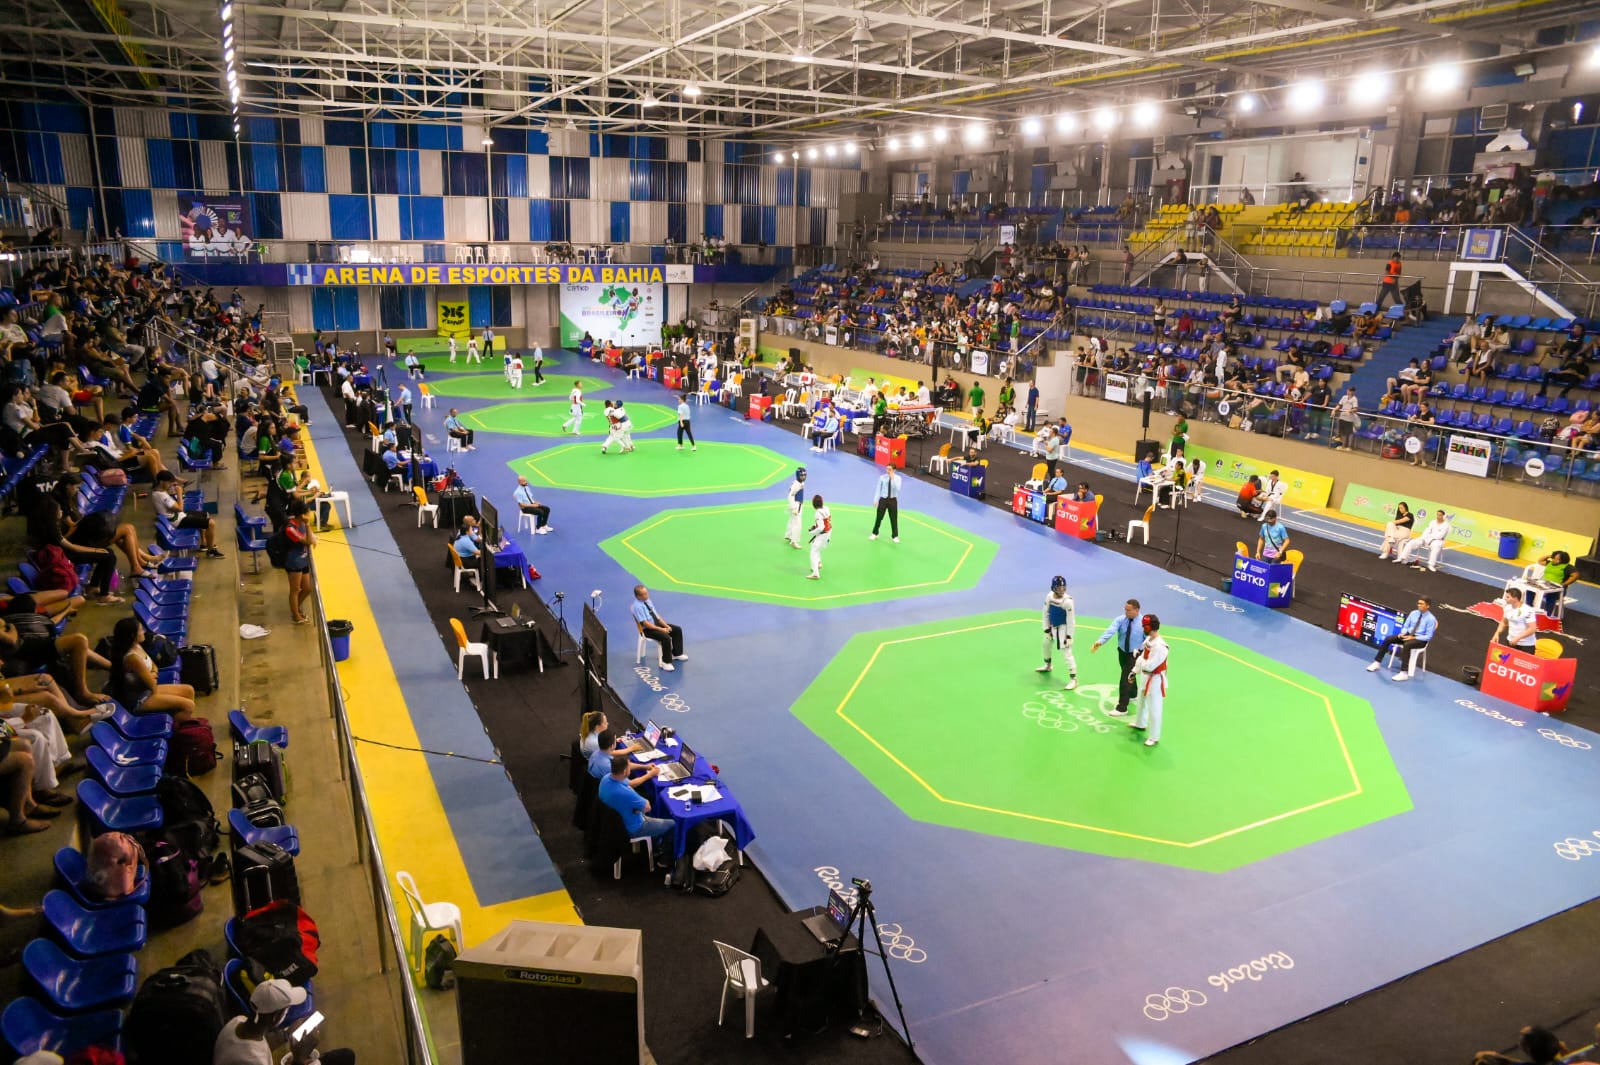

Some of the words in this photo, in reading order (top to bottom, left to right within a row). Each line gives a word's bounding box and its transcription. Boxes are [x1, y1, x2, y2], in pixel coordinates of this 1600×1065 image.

[323, 266, 404, 285] ARENA
[411, 266, 440, 284] DE
[448, 266, 561, 284] ESPORTES
[568, 266, 595, 283] DA
[602, 266, 663, 283] BAHIA
[1234, 570, 1266, 587] CBTKD
[1349, 611, 1358, 625] 0
[1380, 623, 1389, 635] 0
[1487, 662, 1537, 687] CBTKD
[519, 970, 577, 984] Rotoplast
